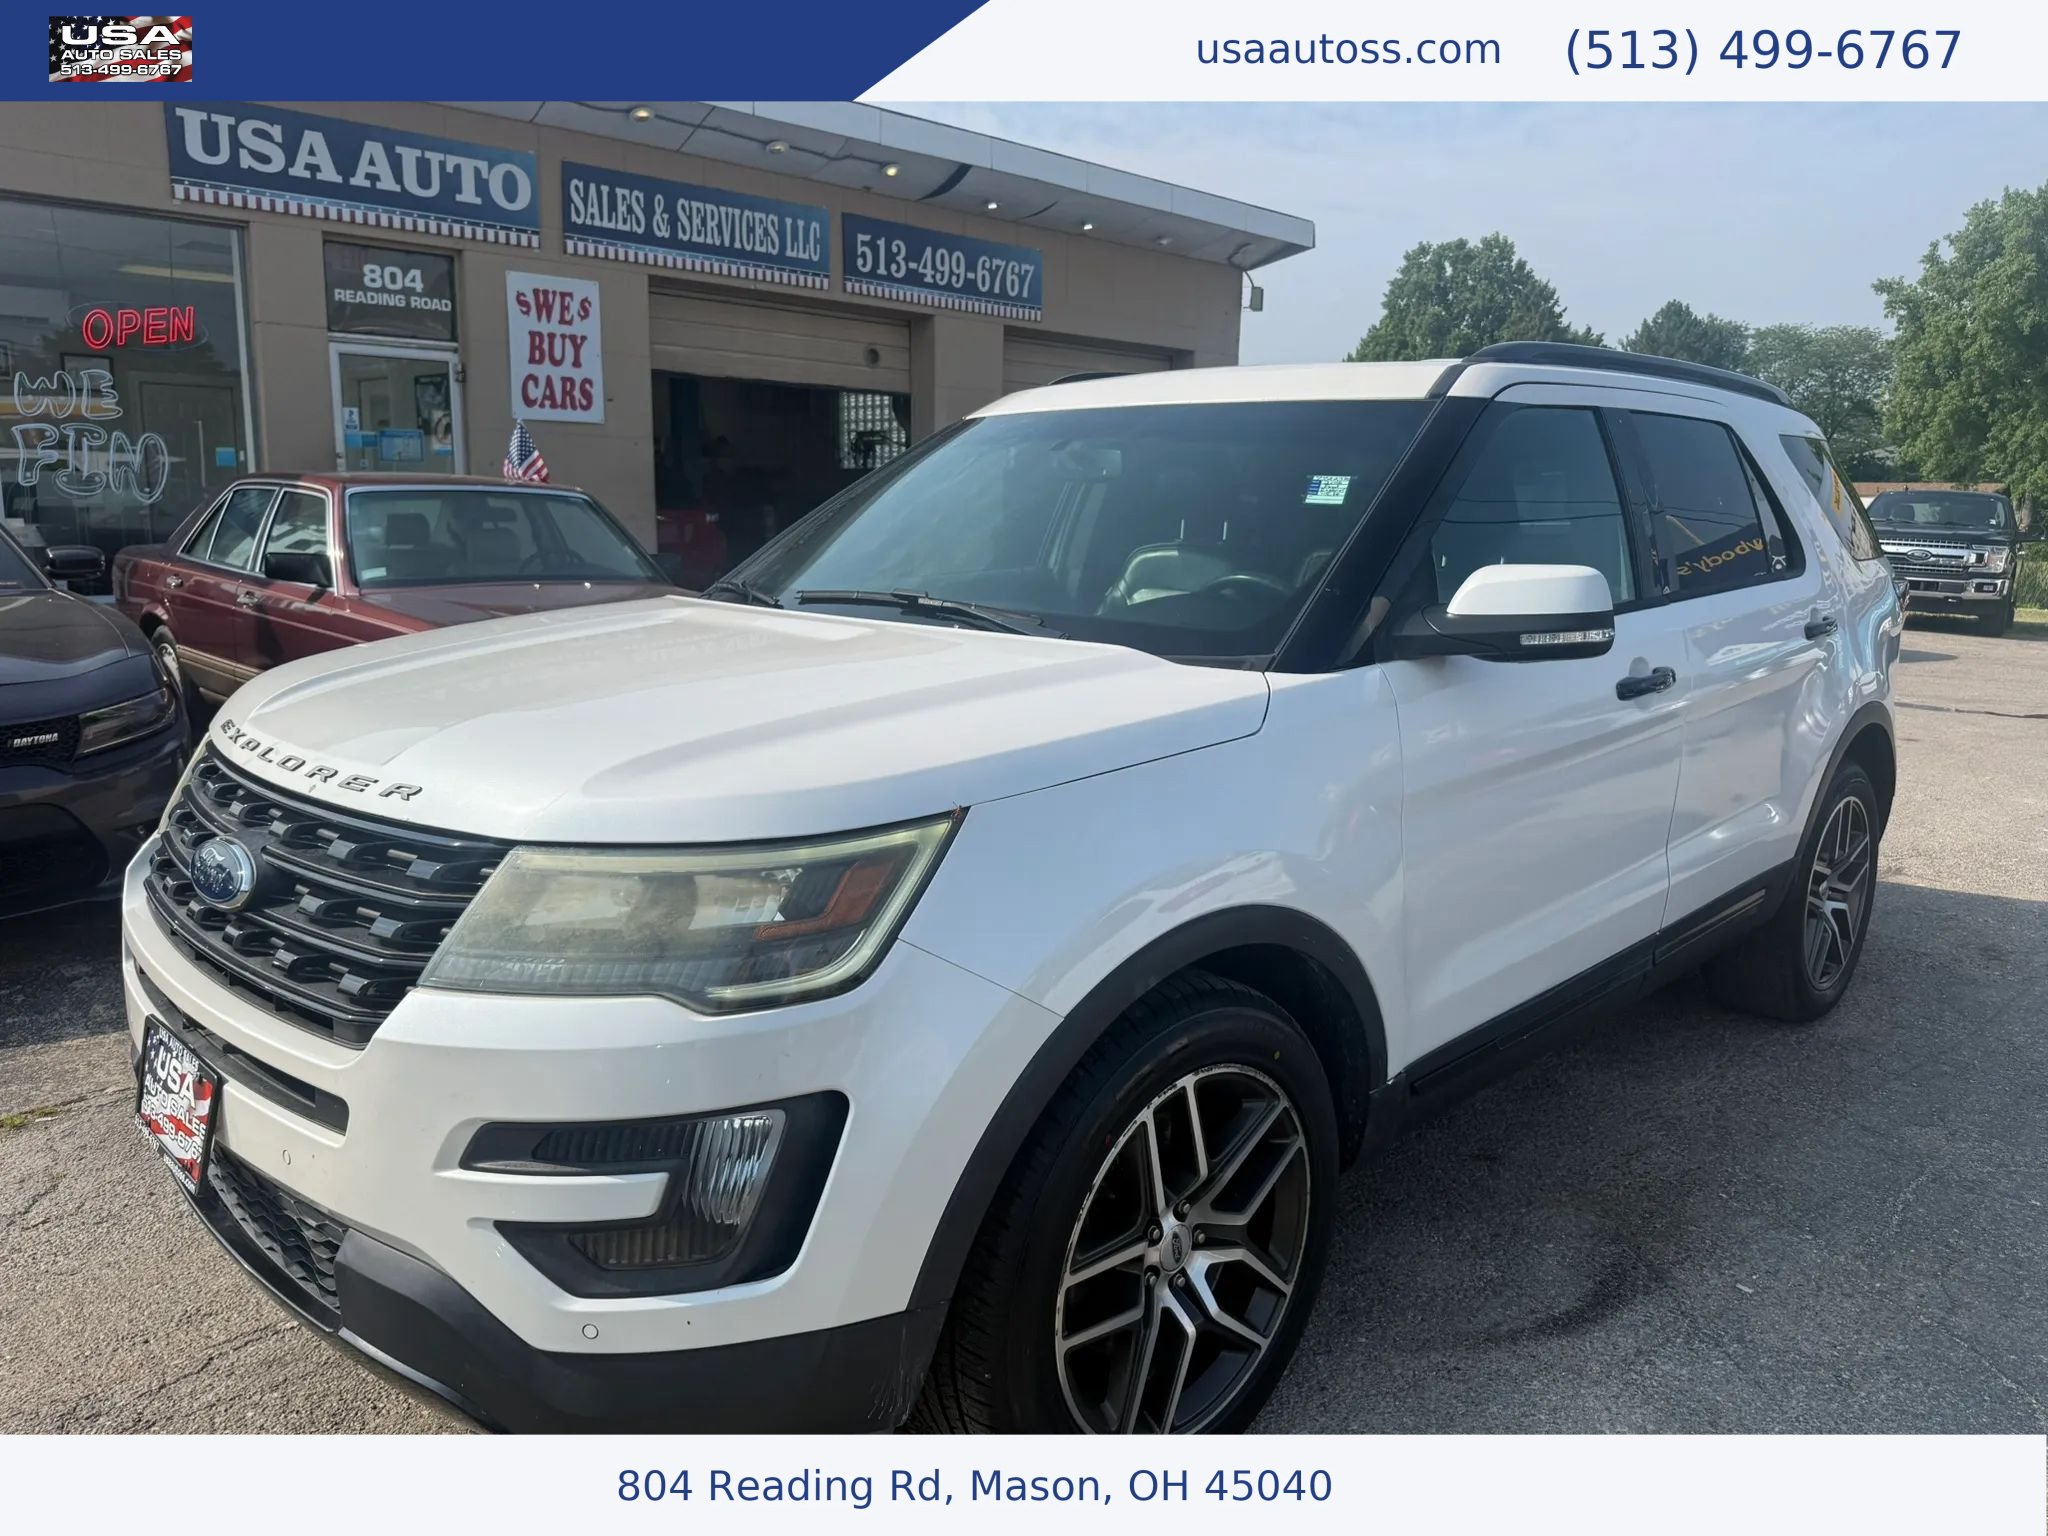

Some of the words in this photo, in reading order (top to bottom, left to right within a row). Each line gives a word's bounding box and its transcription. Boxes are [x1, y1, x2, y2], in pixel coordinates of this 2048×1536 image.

[175, 107, 343, 183] USA
[350, 140, 532, 211] AUTO
[570, 178, 645, 235] SALES
[652, 193, 671, 239] &
[677, 197, 780, 256] SERVICES
[785, 217, 821, 262] LLC
[363, 264, 424, 293] 804
[856, 233, 1035, 299] 513-499-6767
[334, 289, 406, 308] READING
[411, 296, 452, 312] ROAD
[83, 305, 195, 350] OPEN
[528, 330, 588, 369] BUY
[14, 369, 123, 420] WE
[521, 373, 594, 412] CARS
[13, 732, 59, 748] DAYTONA
[220, 718, 423, 802] EXPLORER
[157, 1045, 196, 1109] USA
[144, 1073, 168, 1109] AUTO
[169, 1095, 207, 1141] SALES
